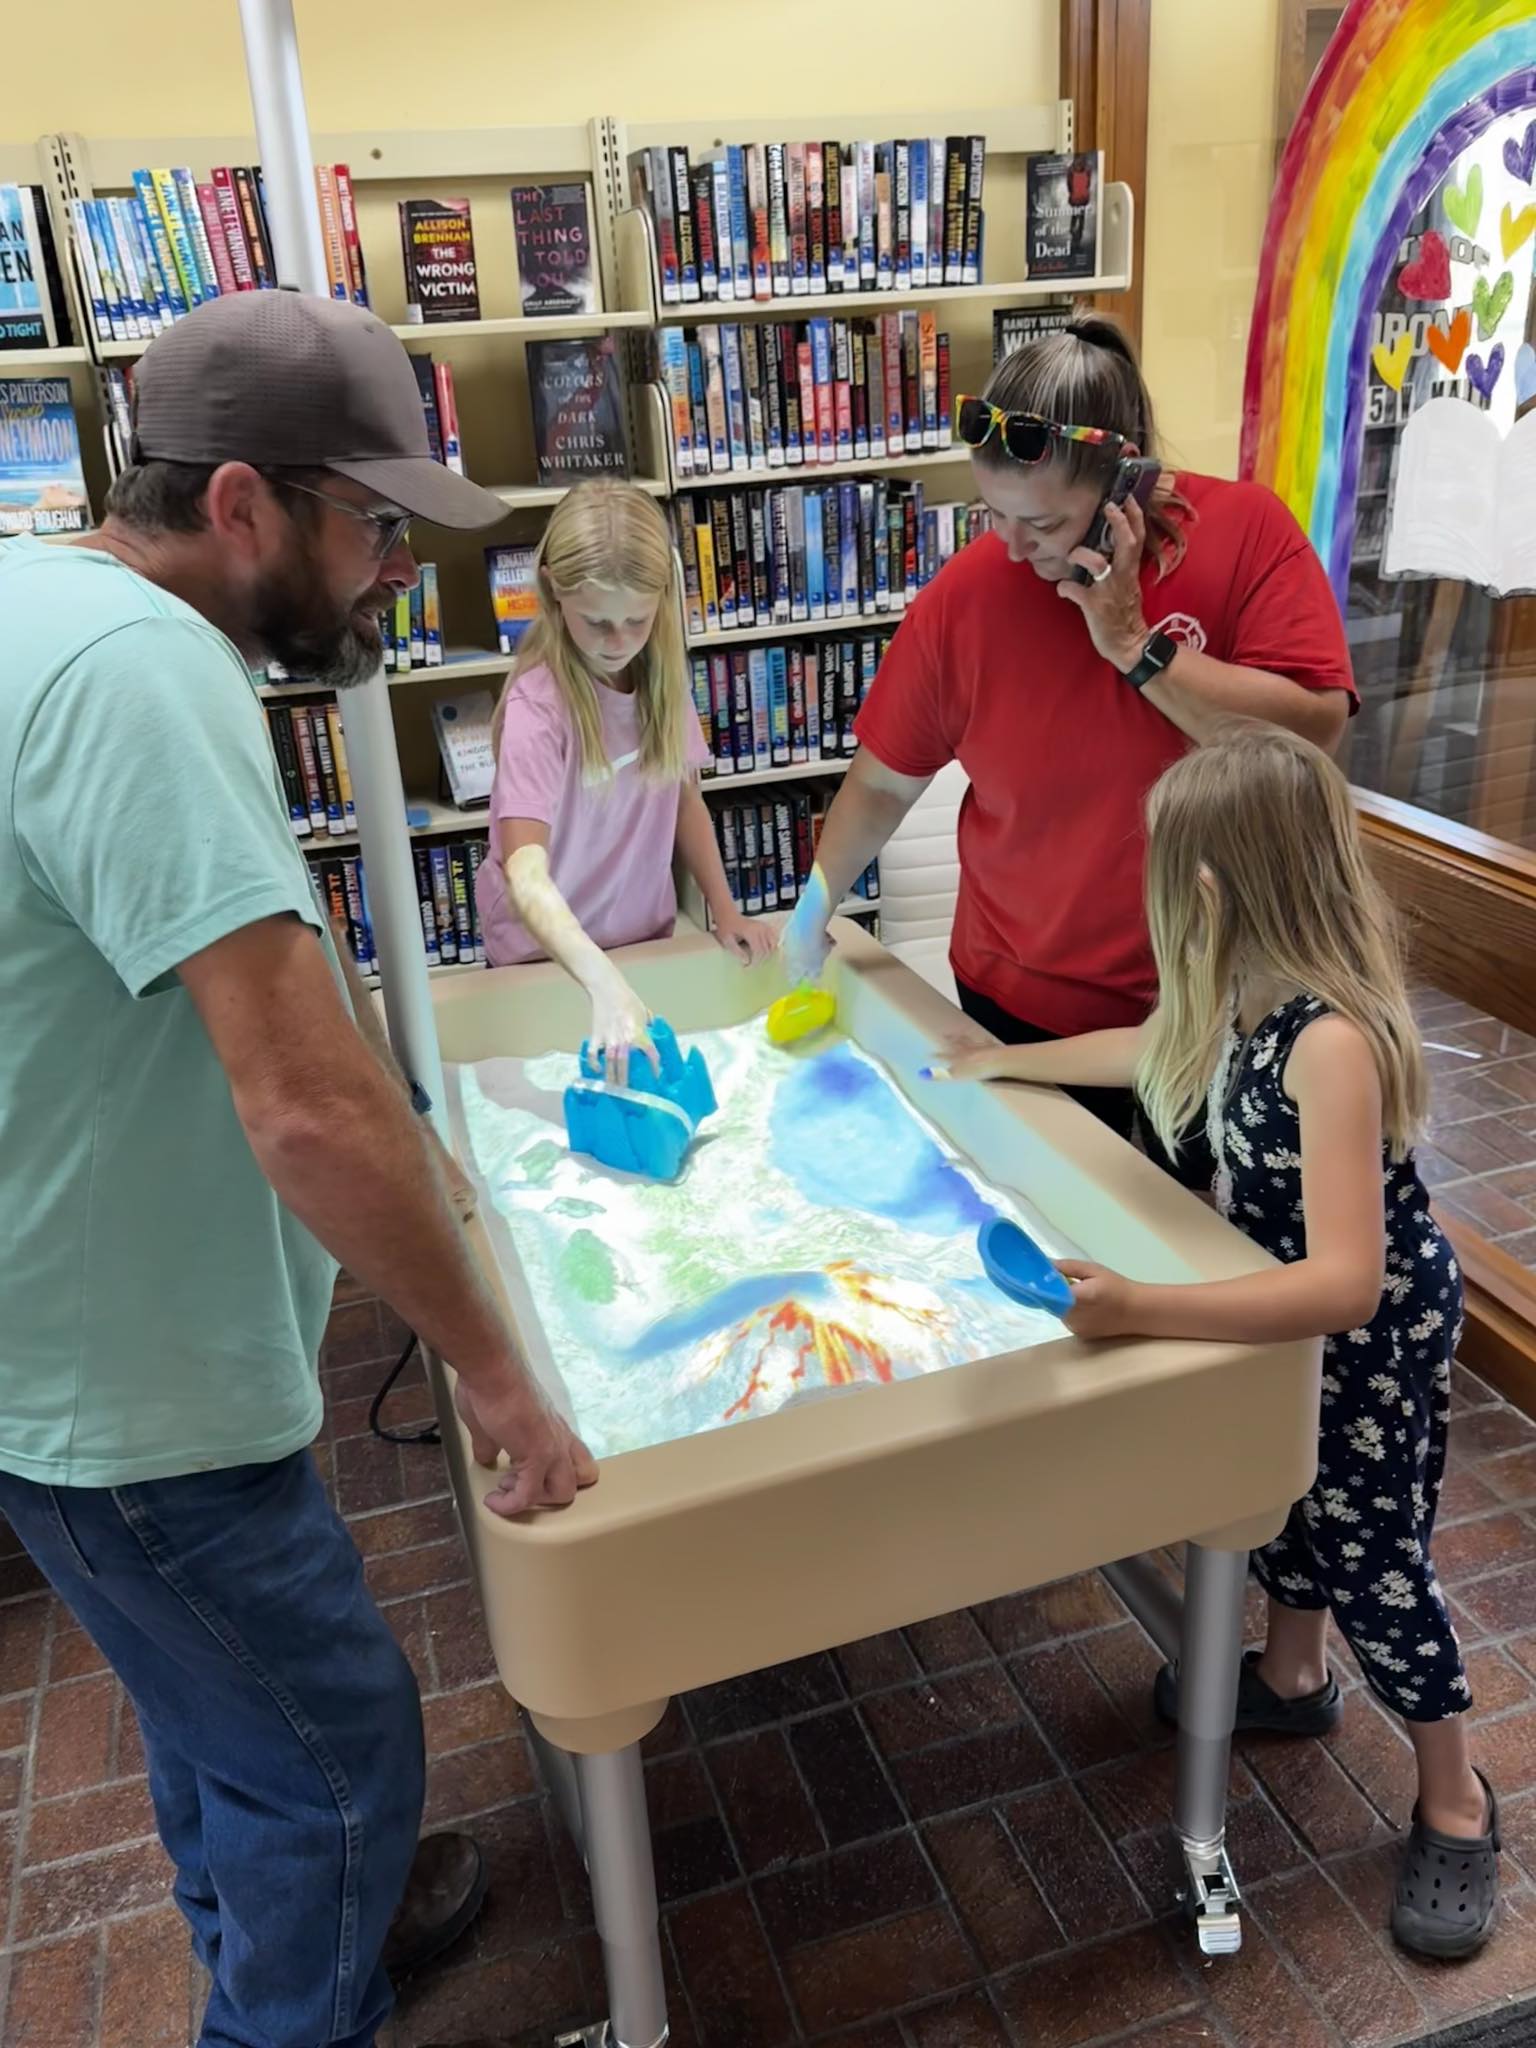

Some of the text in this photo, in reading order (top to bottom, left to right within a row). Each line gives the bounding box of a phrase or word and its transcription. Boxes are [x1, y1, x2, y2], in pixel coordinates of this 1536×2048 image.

[514, 192, 538, 202] THE
[517, 206, 564, 224] LAST
[1035, 206, 1091, 219] Summer
[415, 219, 465, 231] ALLISON
[679, 215, 692, 235] ALEX
[1035, 221, 1070, 237] of the
[214, 187, 254, 282] JANET EVANOVICH
[413, 232, 470, 244] BRENNAN
[518, 226, 582, 246] THING
[432, 247, 456, 259] THE
[535, 249, 586, 266] TOLD
[1035, 241, 1071, 258] Dead
[416, 262, 475, 277] WRONG
[420, 282, 476, 297] VICTIM
[7, 322, 42, 340] TIGHT
[1002, 318, 1037, 331] RANDY
[921, 324, 934, 362] SAIL
[11, 382, 69, 403] PATTERSON
[557, 410, 597, 425] DARK
[555, 434, 605, 450] CHRIS
[540, 453, 625, 469] WHITAKER
[820, 643, 837, 721] JOHN SANDFORD
[774, 802, 790, 830] JOHN
[342, 861, 359, 892] JUSTICE
[420, 900, 435, 928] QUEEN
